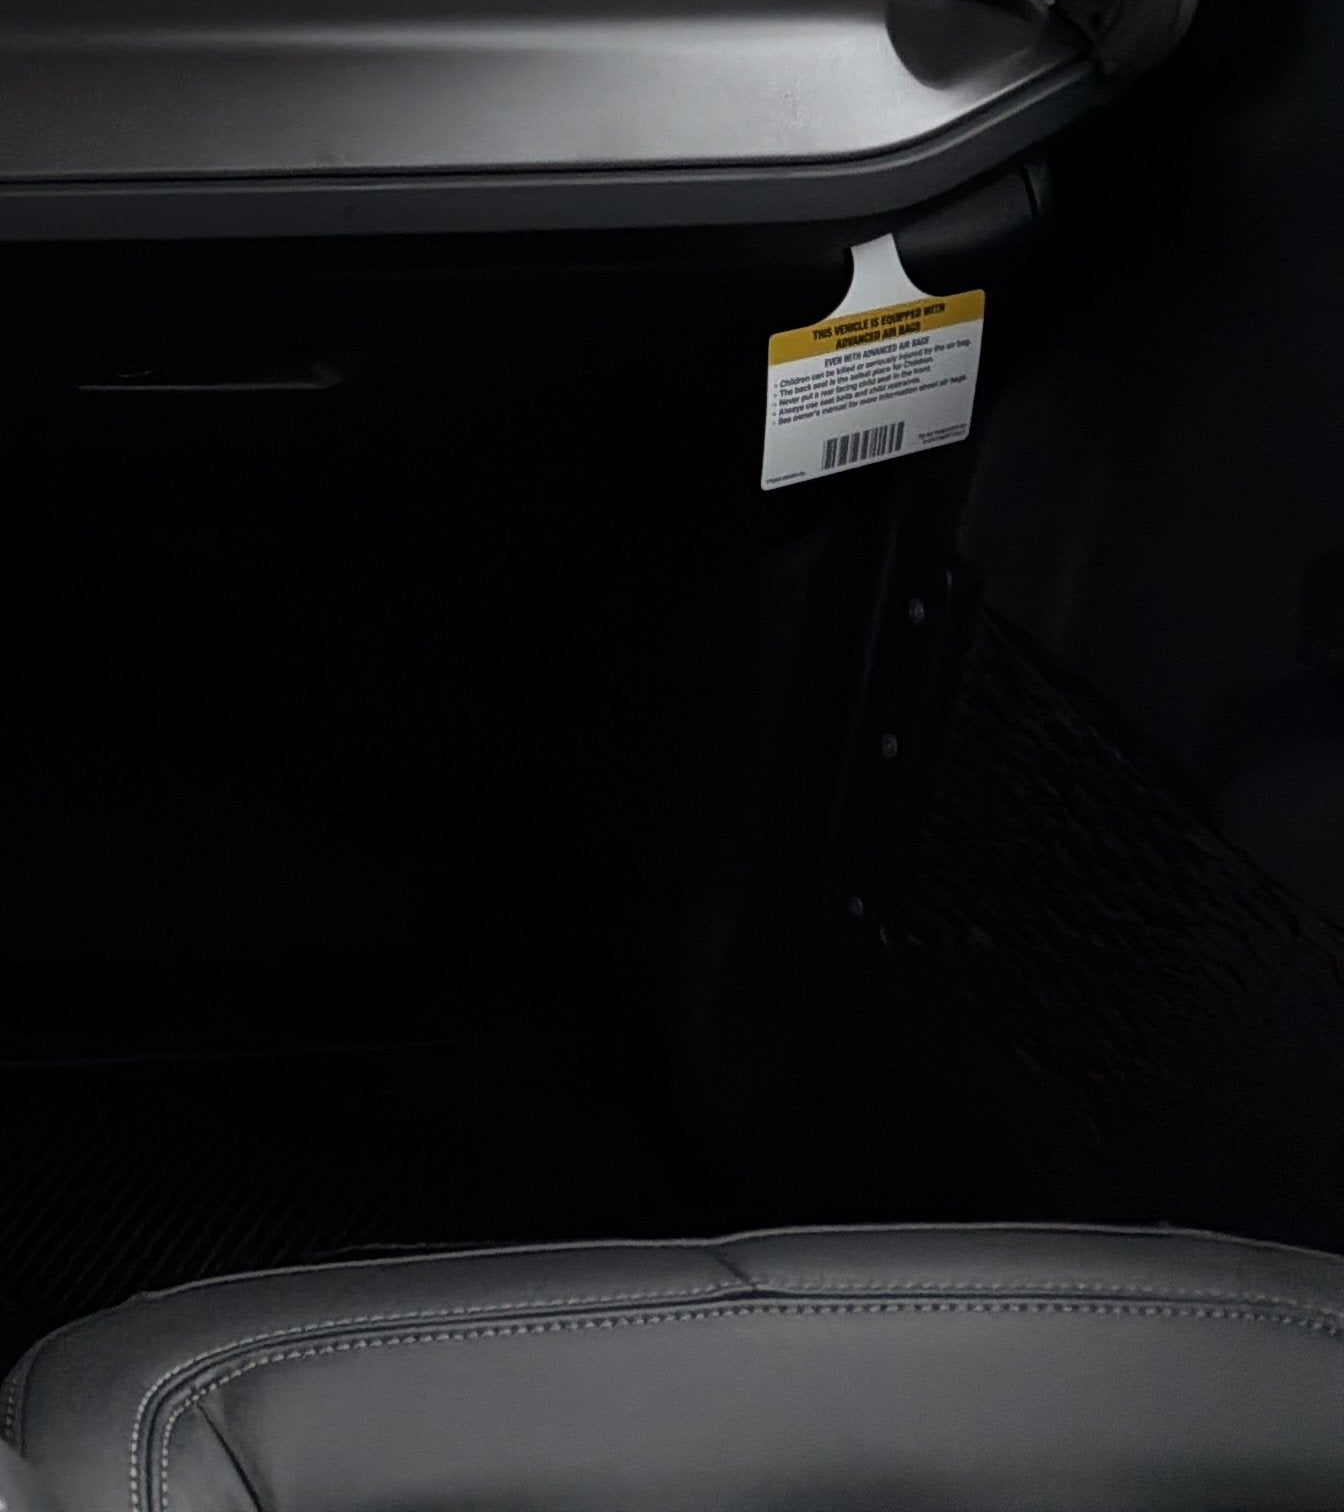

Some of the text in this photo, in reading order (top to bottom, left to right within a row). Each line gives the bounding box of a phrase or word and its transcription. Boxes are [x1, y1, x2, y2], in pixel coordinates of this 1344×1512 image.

[813, 326, 833, 340] THIS
[834, 318, 869, 335] VEHICLE
[836, 330, 881, 350] ADVANCED
